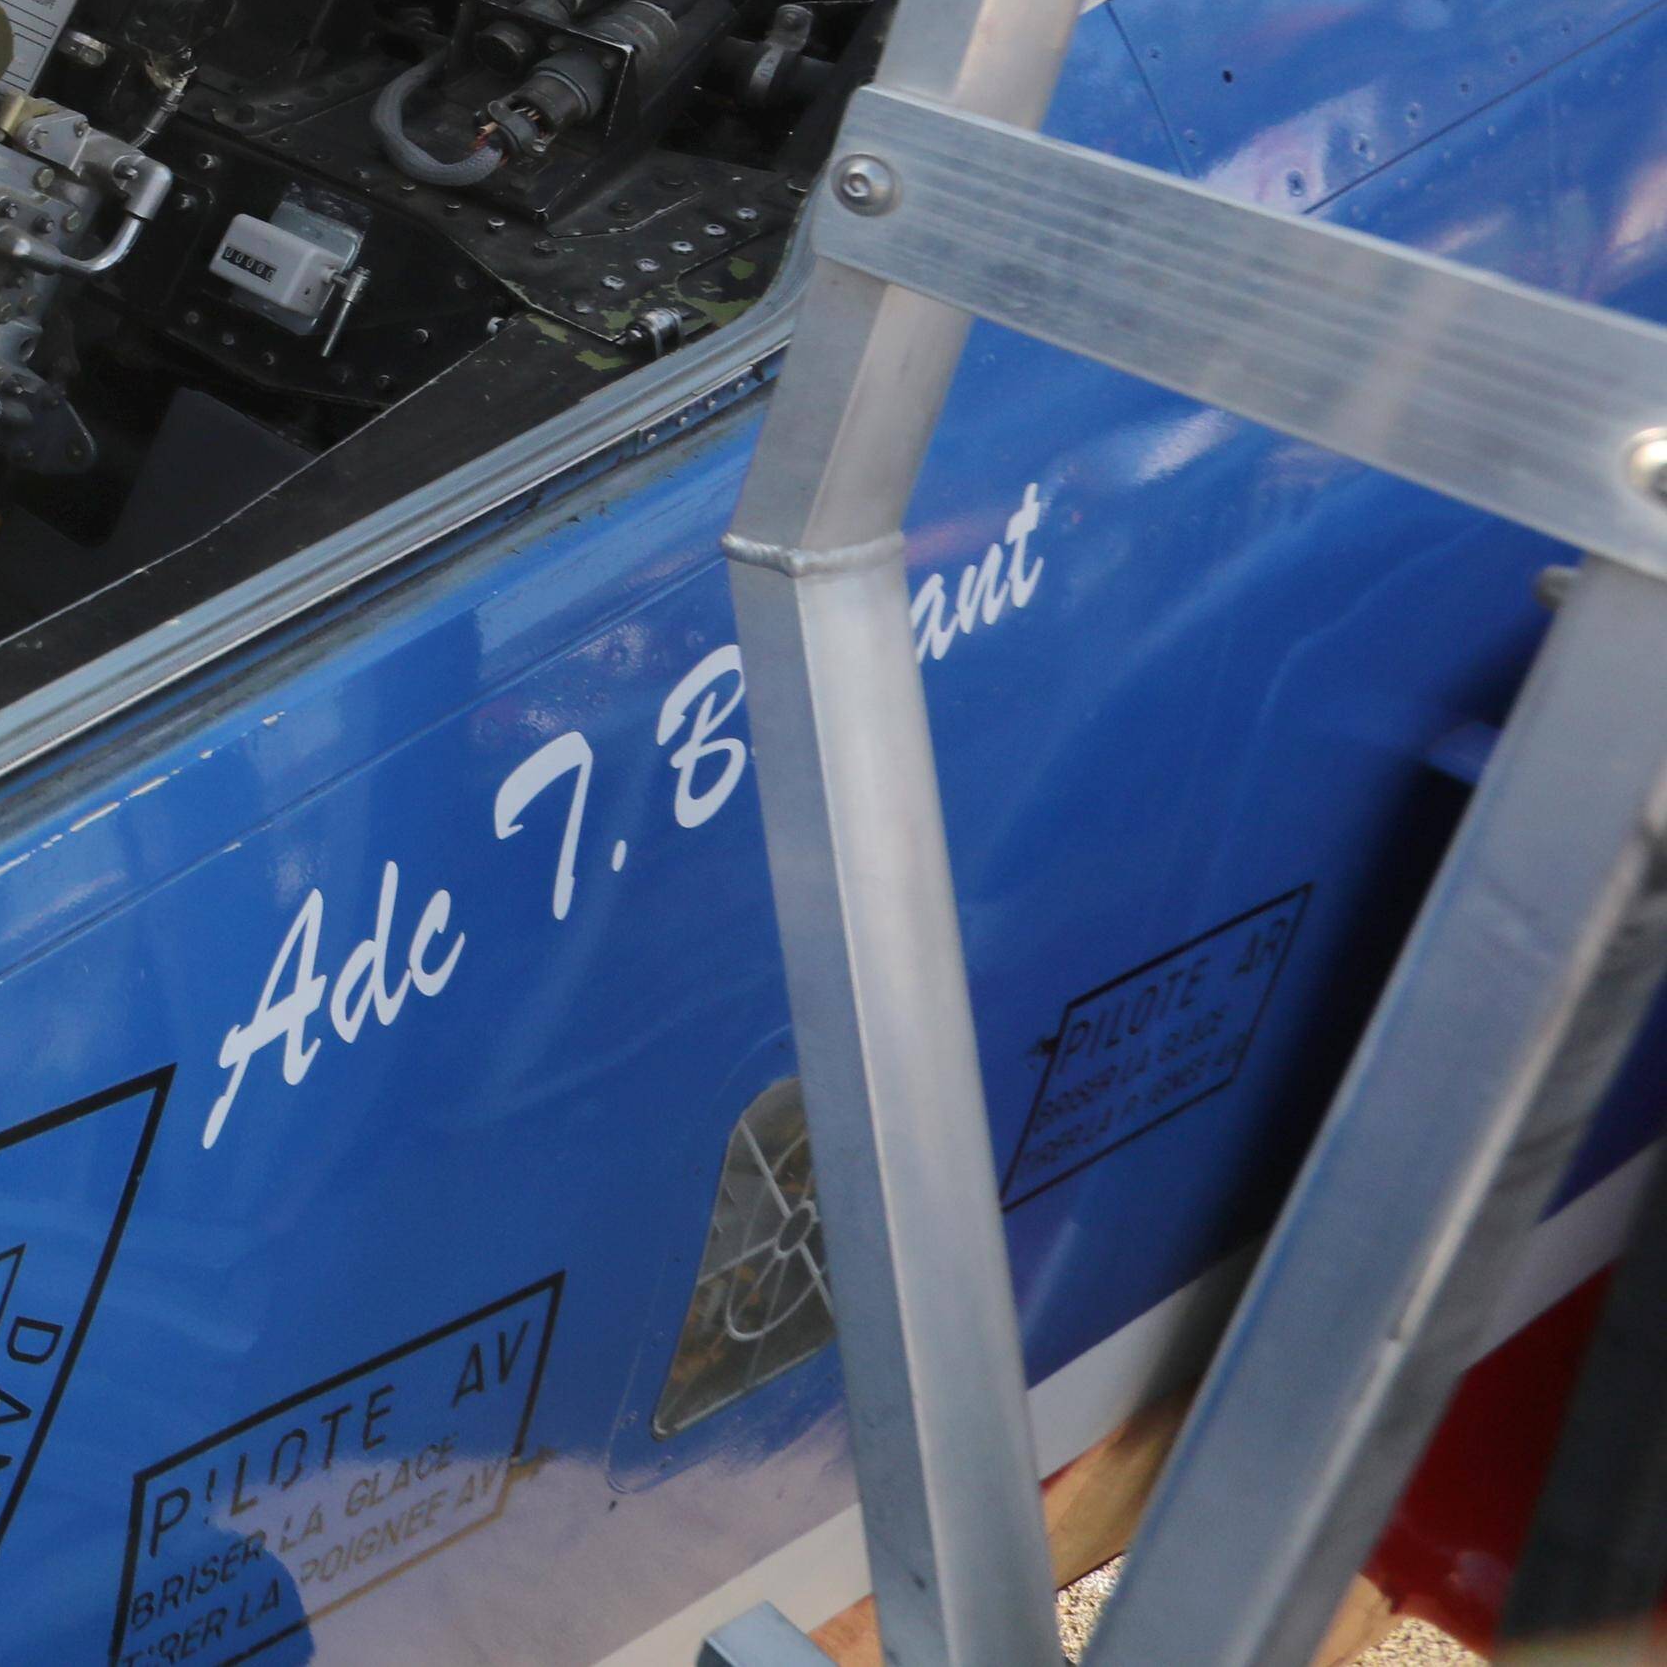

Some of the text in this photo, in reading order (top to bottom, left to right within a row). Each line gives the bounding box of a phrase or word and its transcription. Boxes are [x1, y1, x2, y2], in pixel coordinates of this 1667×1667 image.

[204, 861, 466, 1149] Adc
[1060, 918, 1286, 1073] PILOTE AR
[131, 1431, 459, 1633] BRISER LA GLACE
[148, 1320, 530, 1559] PILOTE AV
[237, 1577, 283, 1630] LA
[299, 1488, 446, 1588] POIGNEE
[455, 1460, 506, 1513] AV
